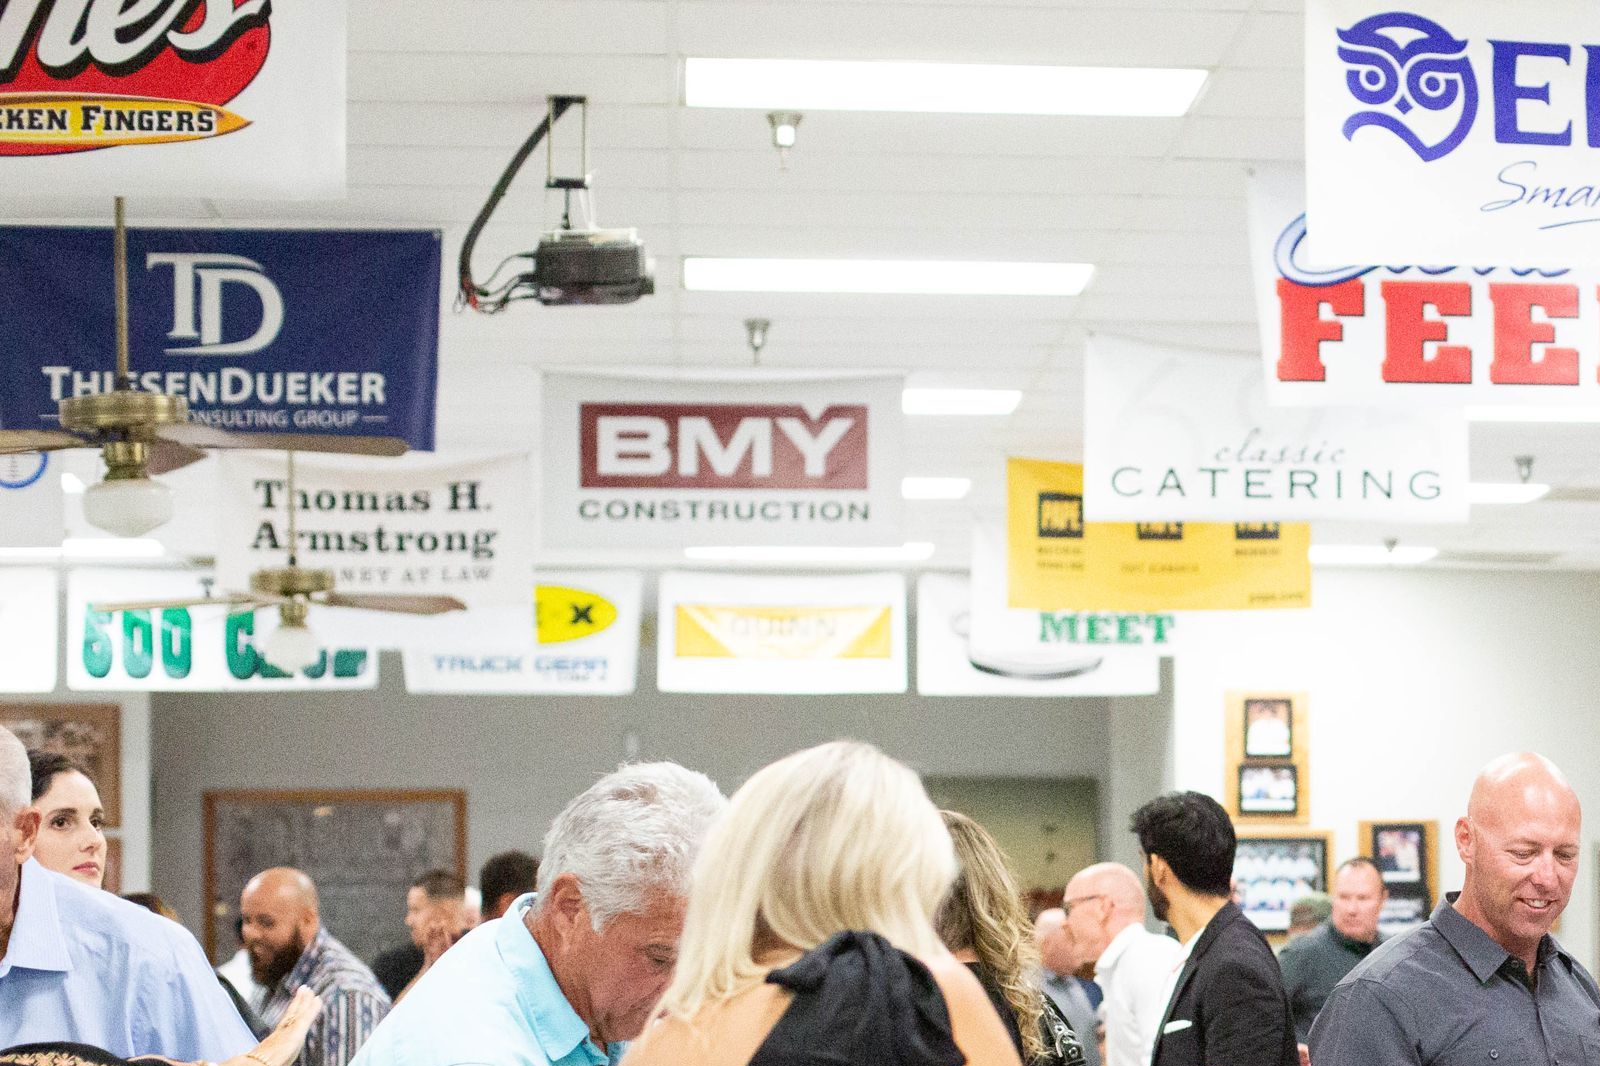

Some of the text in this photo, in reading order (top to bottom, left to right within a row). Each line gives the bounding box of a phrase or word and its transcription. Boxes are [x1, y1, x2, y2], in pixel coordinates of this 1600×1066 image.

[0, 105, 215, 132] KEN FINGERS
[186, 410, 359, 427] ONSULTING GROUP
[597, 415, 853, 478] BMY
[1214, 427, 1348, 465] classic
[448, 480, 492, 511] H.
[1110, 466, 1443, 501] CATERING
[578, 499, 870, 522] CONSTRUCTION
[1039, 611, 1175, 643] MEET
